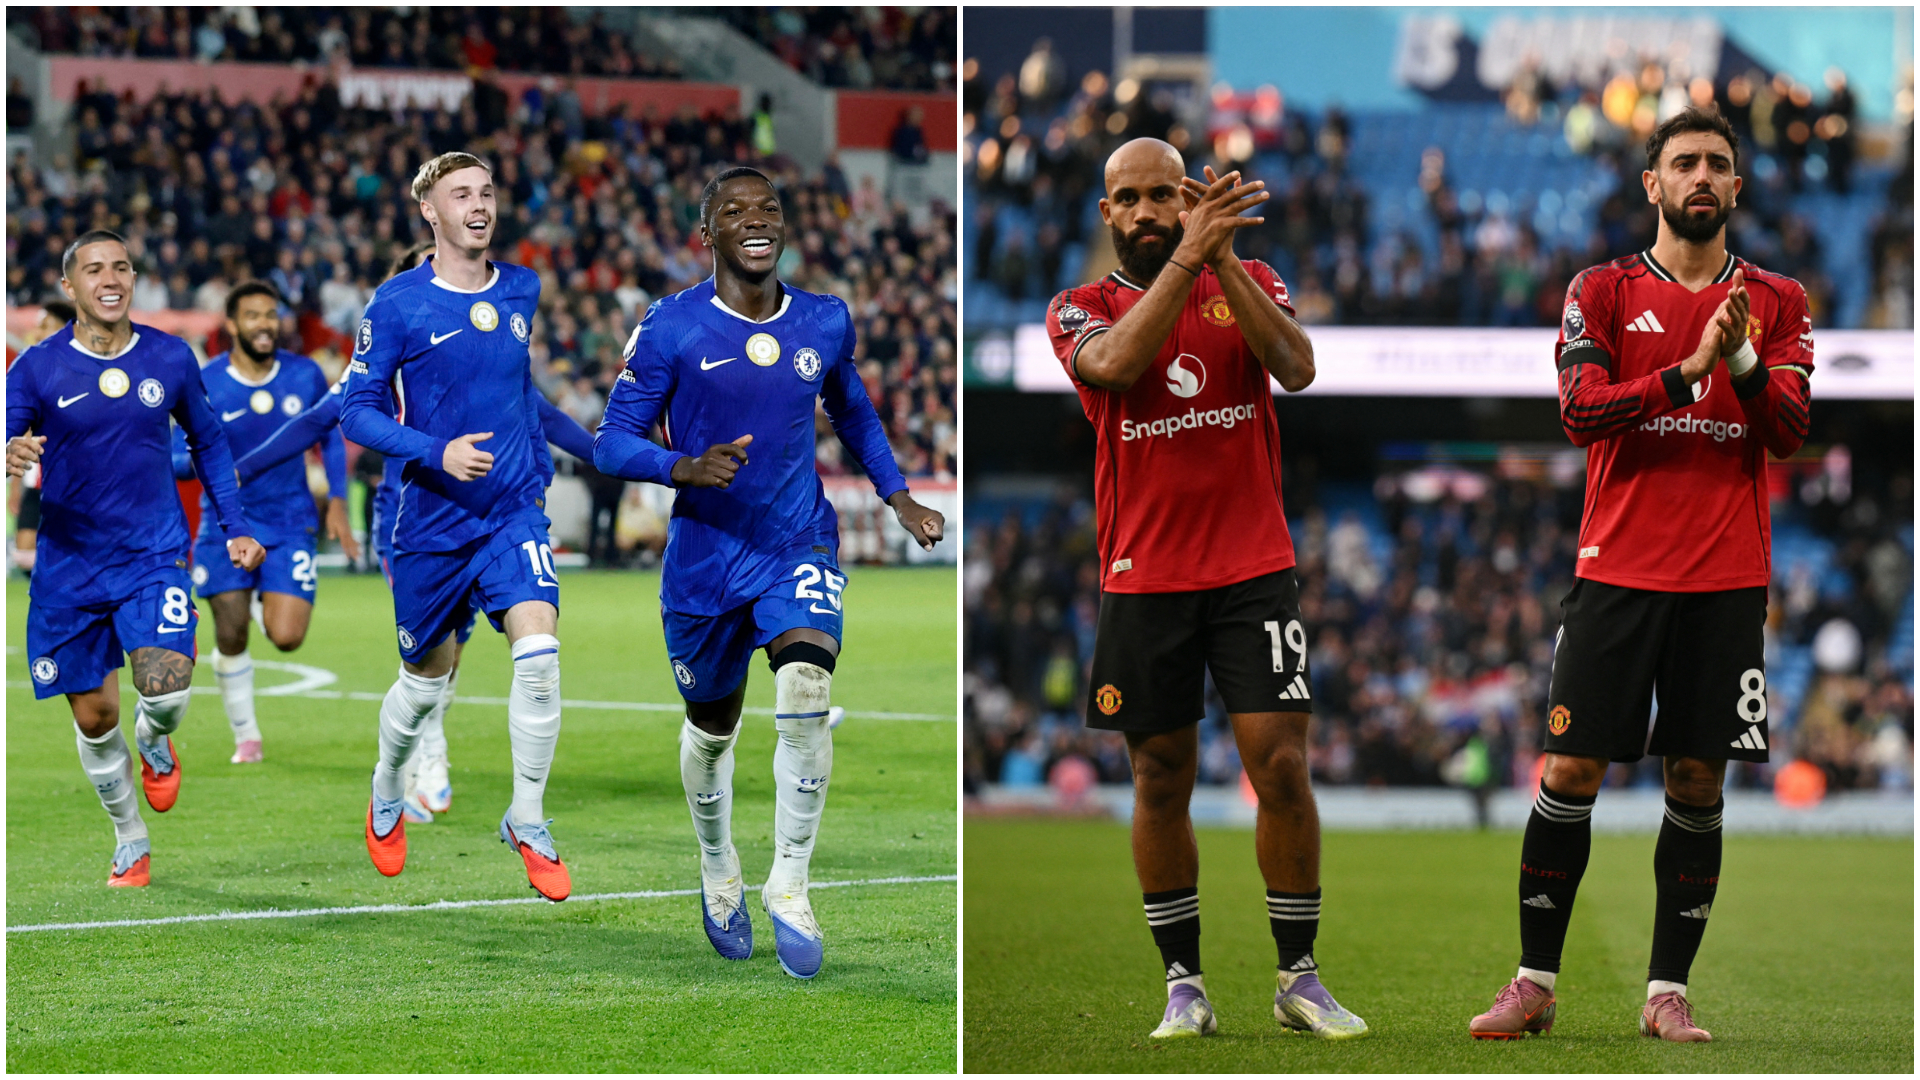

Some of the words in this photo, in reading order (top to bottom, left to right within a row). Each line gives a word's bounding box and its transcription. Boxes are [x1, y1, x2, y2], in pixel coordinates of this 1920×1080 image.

[1121, 403, 1257, 442] Snapdragon
[1639, 413, 1749, 443] apdrago
[522, 540, 559, 584] 10
[162, 586, 189, 626] 8
[793, 563, 845, 612] 25
[1264, 619, 1307, 673] 19
[1737, 668, 1767, 723] 8
